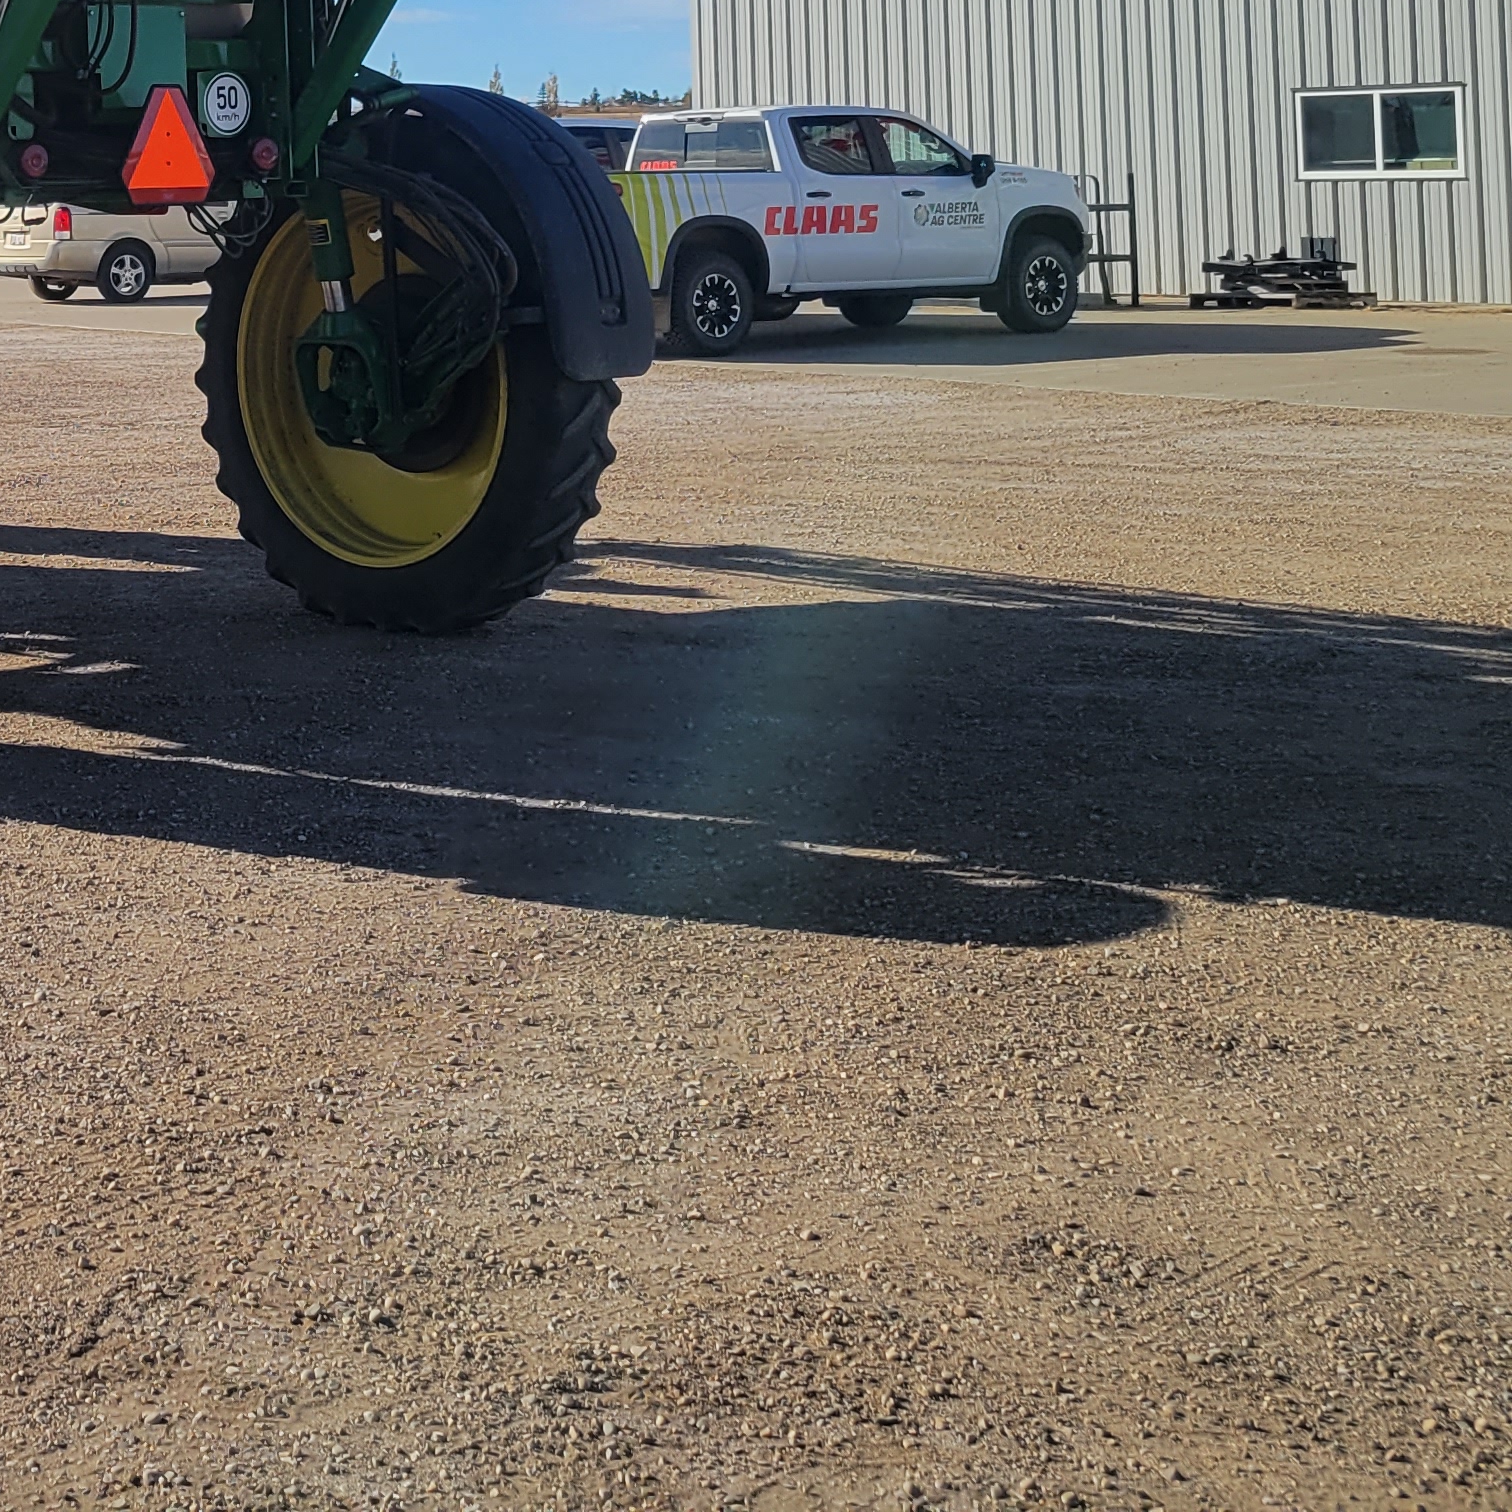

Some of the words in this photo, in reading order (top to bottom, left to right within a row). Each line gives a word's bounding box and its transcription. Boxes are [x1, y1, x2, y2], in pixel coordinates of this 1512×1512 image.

[216, 85, 238, 110] 50
[216, 111, 240, 122] km/h
[640, 159, 677, 171] CLAAS
[934, 201, 979, 214] ALBERTA
[764, 203, 879, 236] CLAAS
[930, 215, 945, 227] AG
[947, 213, 985, 226] CENTRE
